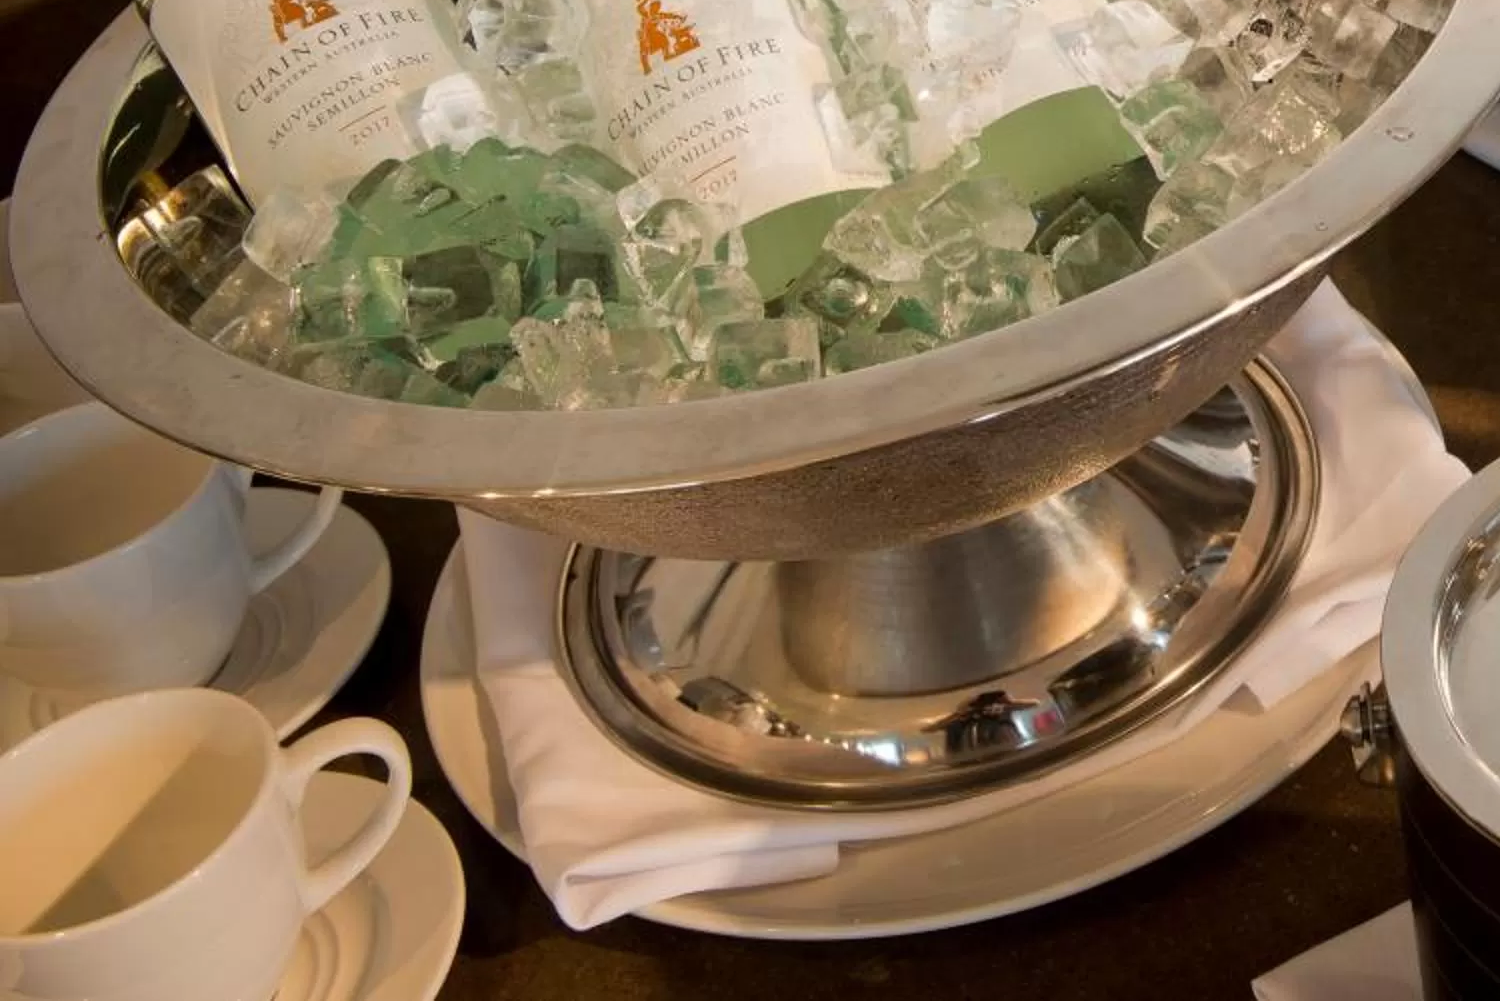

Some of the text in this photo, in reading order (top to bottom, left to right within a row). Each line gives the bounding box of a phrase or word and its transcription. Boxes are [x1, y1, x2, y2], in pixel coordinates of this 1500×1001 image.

[235, 8, 425, 113] CHAIN OF FIRE
[267, 52, 433, 149] SAUVIGNON BLANC
[306, 77, 401, 132] SEMILLON
[607, 38, 782, 142] CHAIN OF FIRE
